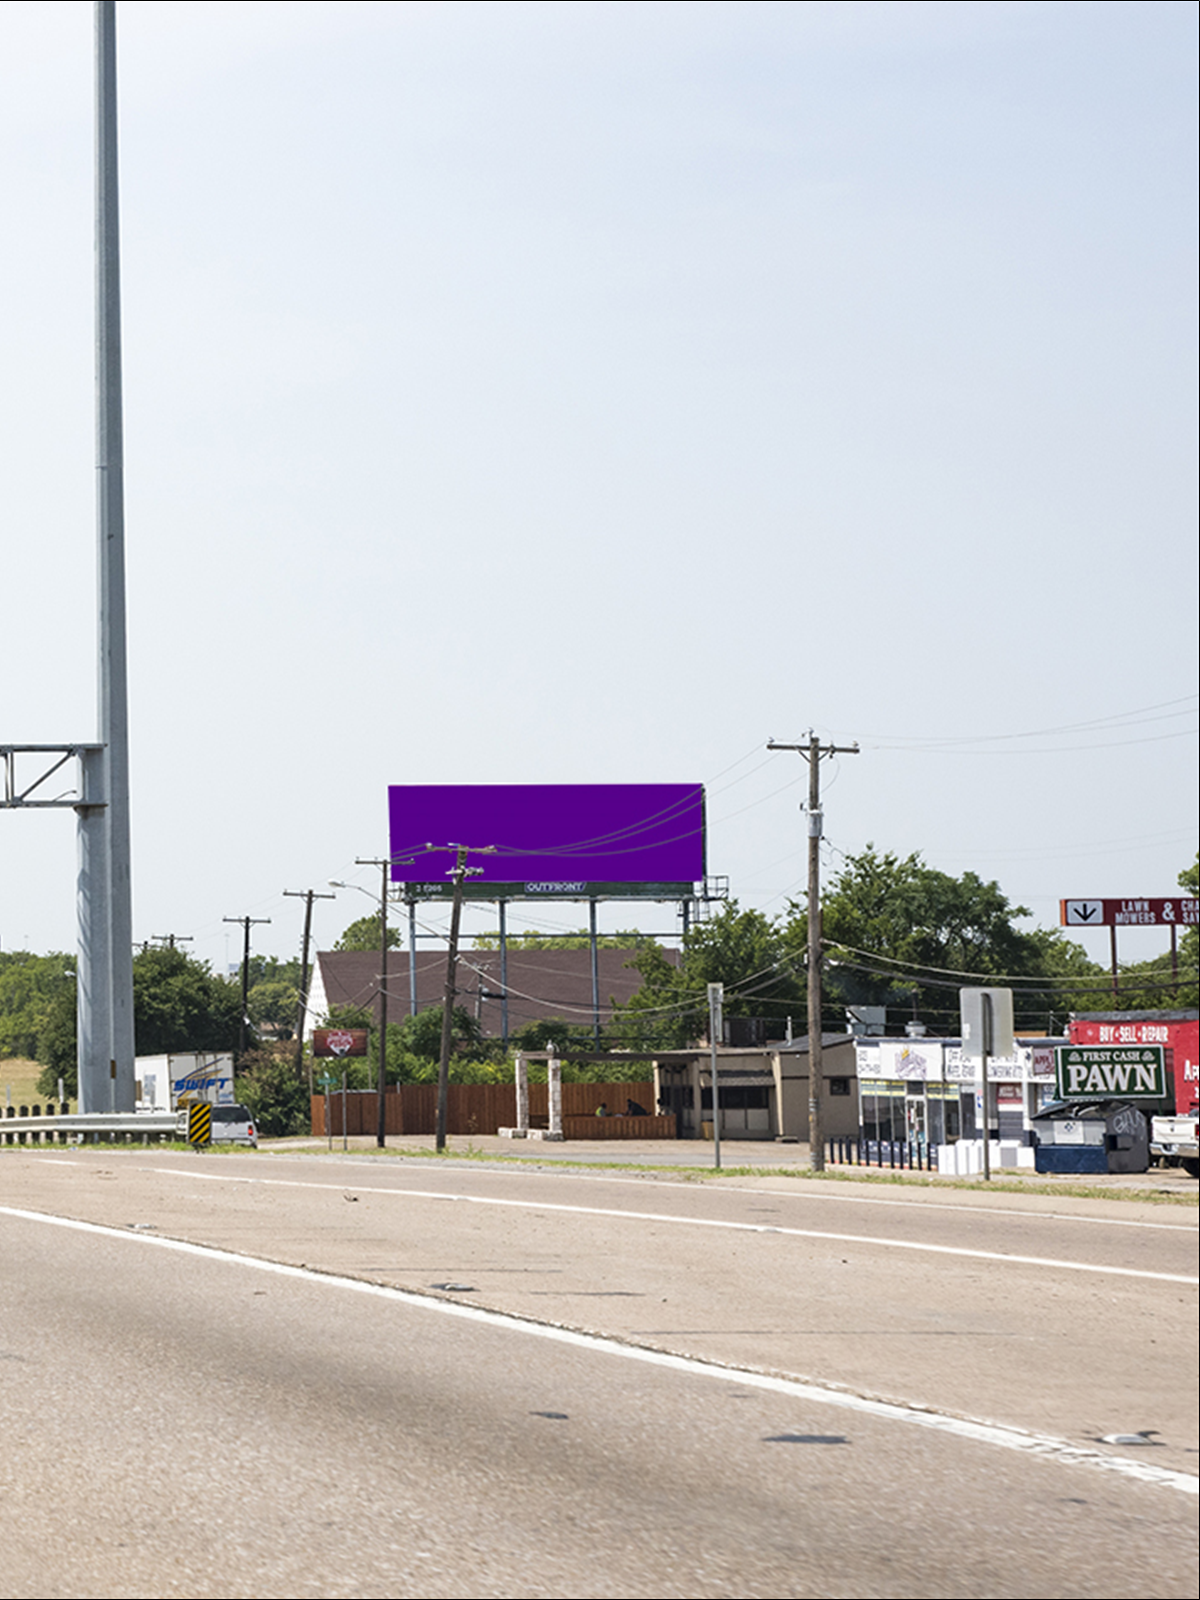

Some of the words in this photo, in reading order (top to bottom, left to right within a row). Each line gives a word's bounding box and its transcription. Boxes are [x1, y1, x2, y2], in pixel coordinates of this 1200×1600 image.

[527, 883, 583, 892] OUTFRONT
[1121, 900, 1150, 912] LAWN
[1115, 912, 1156, 924] MOWERS
[1100, 1026, 1114, 1042] BUY
[1119, 1026, 1137, 1042] SELL
[1141, 1026, 1168, 1042] REPAIR
[1083, 1052, 1111, 1061] FIRST
[1113, 1052, 1140, 1061] CASH
[173, 1077, 230, 1091] SWIFT
[1067, 1064, 1157, 1093] PAWN
